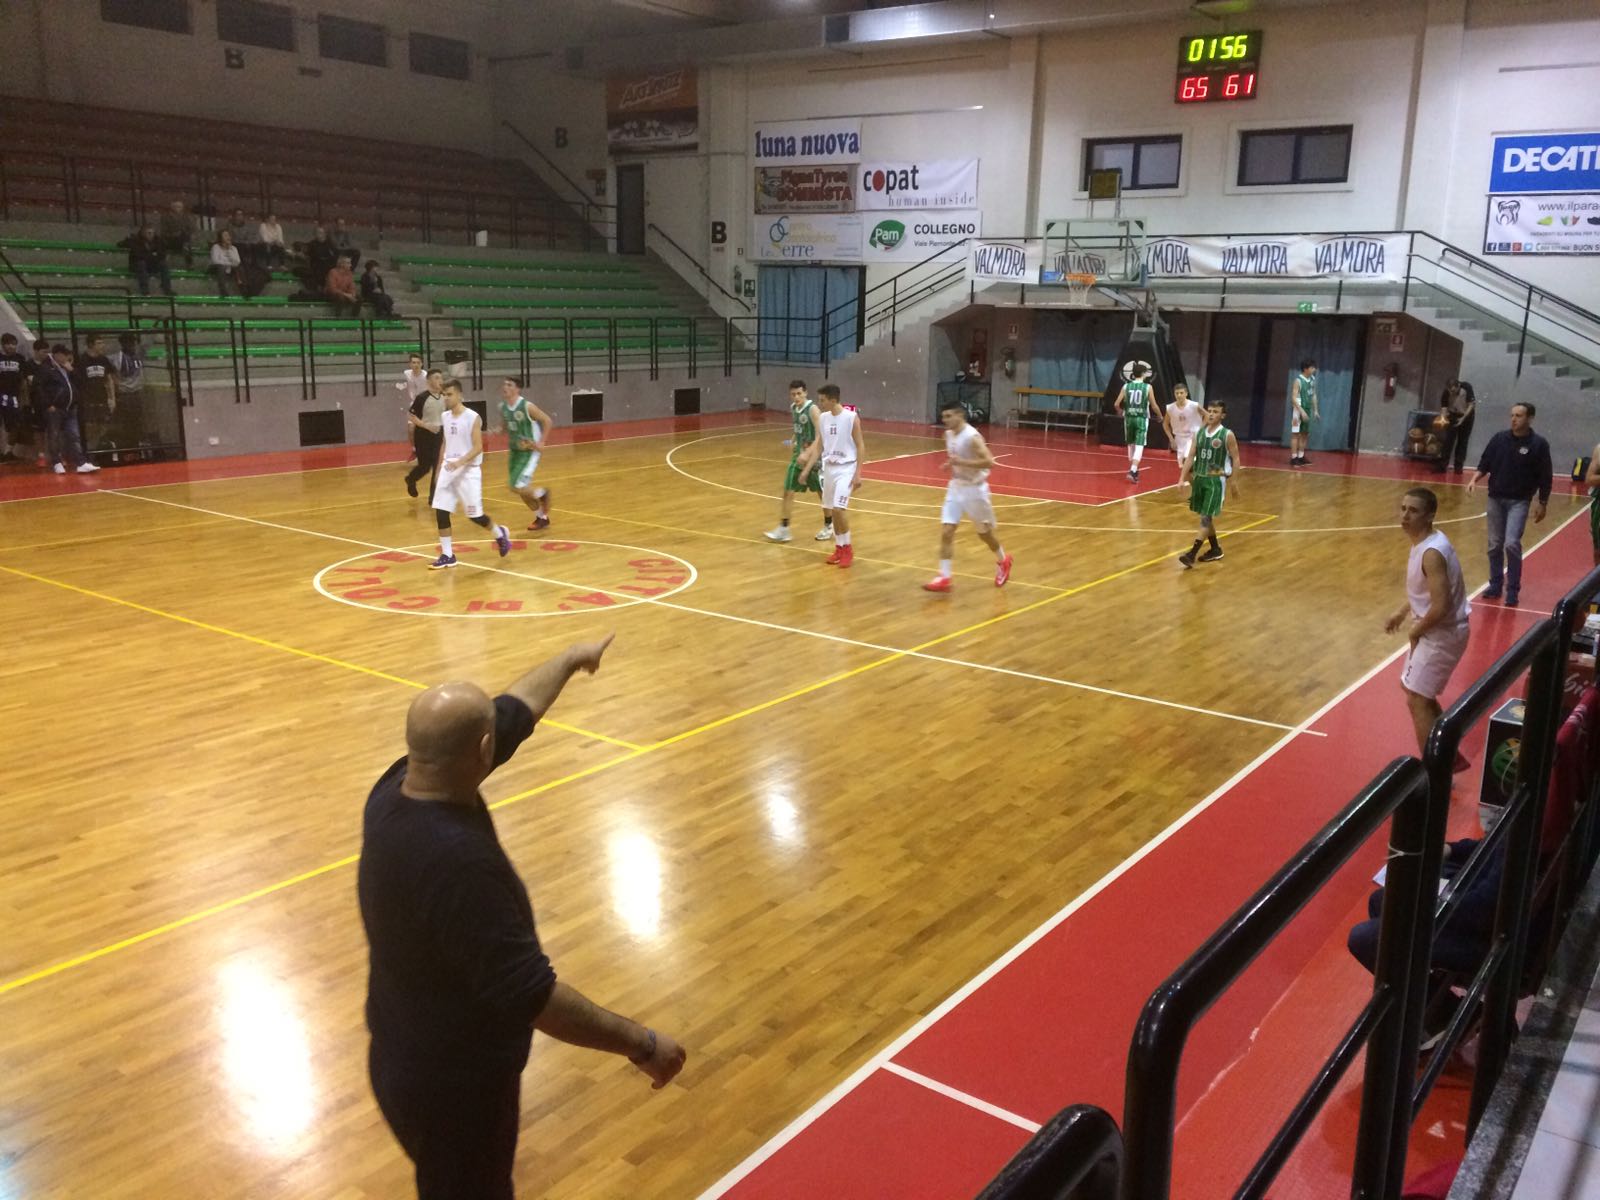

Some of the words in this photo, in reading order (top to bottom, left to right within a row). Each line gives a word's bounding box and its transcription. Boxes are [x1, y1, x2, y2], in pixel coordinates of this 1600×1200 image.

[224, 48, 245, 69] B
[1182, 76, 1209, 99] 65
[1225, 74, 1255, 96] 61
[755, 131, 796, 158] luna
[800, 132, 859, 156] nuova
[863, 165, 919, 195] copat
[888, 194, 927, 207] human
[935, 192, 974, 206] inside
[711, 221, 728, 244] B
[875, 228, 900, 241] Pam
[914, 223, 976, 235] COLLEGNO
[975, 246, 1026, 277] VALMORA
[1222, 242, 1289, 274] VALMORA
[1315, 240, 1385, 273] VALMORA
[1128, 389, 1142, 405] 70
[1201, 448, 1213, 460] 69
